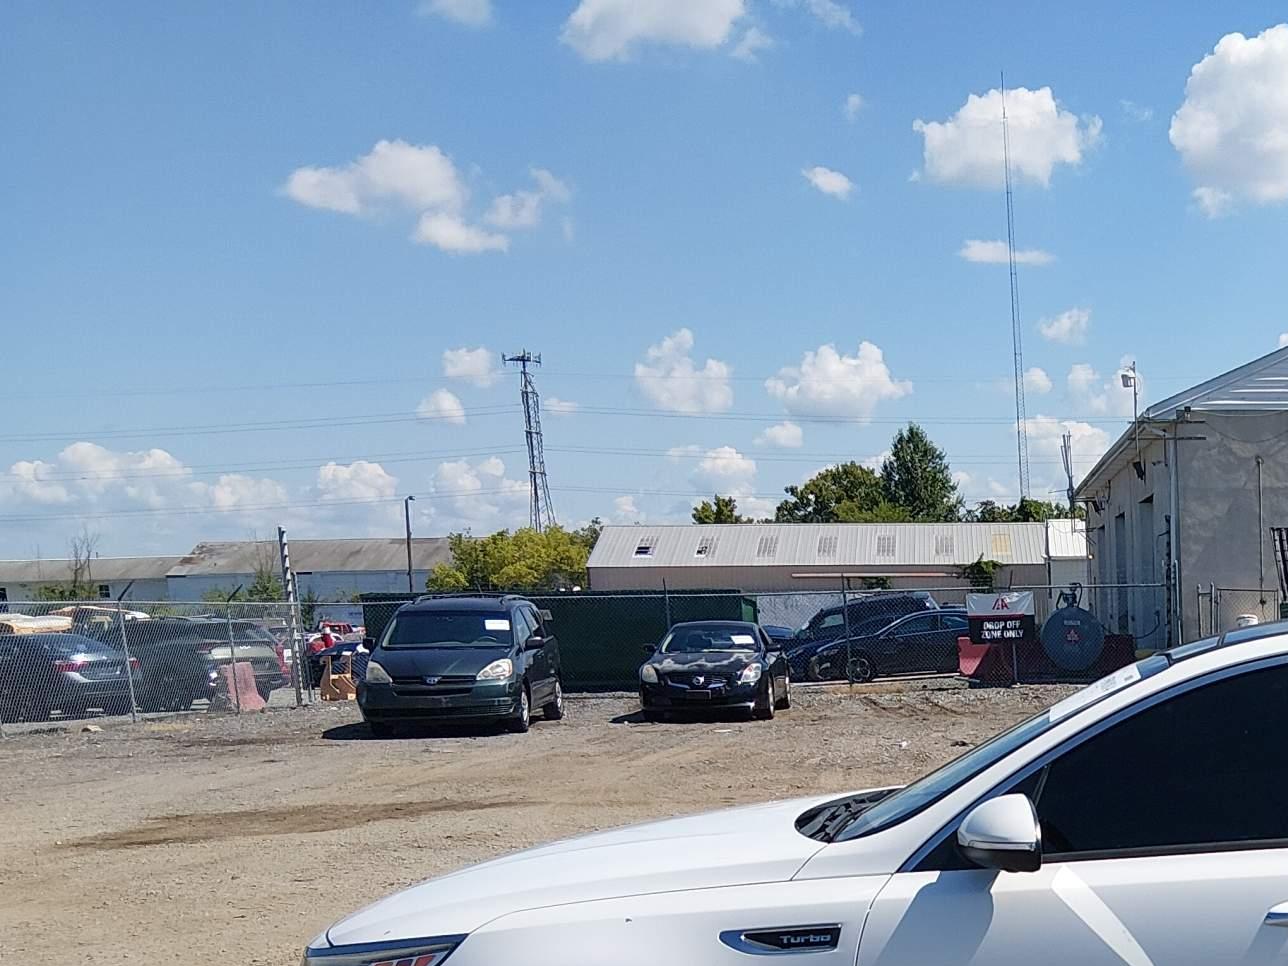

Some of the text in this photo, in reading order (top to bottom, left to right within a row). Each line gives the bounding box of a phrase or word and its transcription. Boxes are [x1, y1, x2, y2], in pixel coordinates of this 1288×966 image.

[983, 620, 1021, 630] DROP OFF
[980, 629, 1024, 639] ZONE ONLY
[780, 934, 831, 944] Turbo
